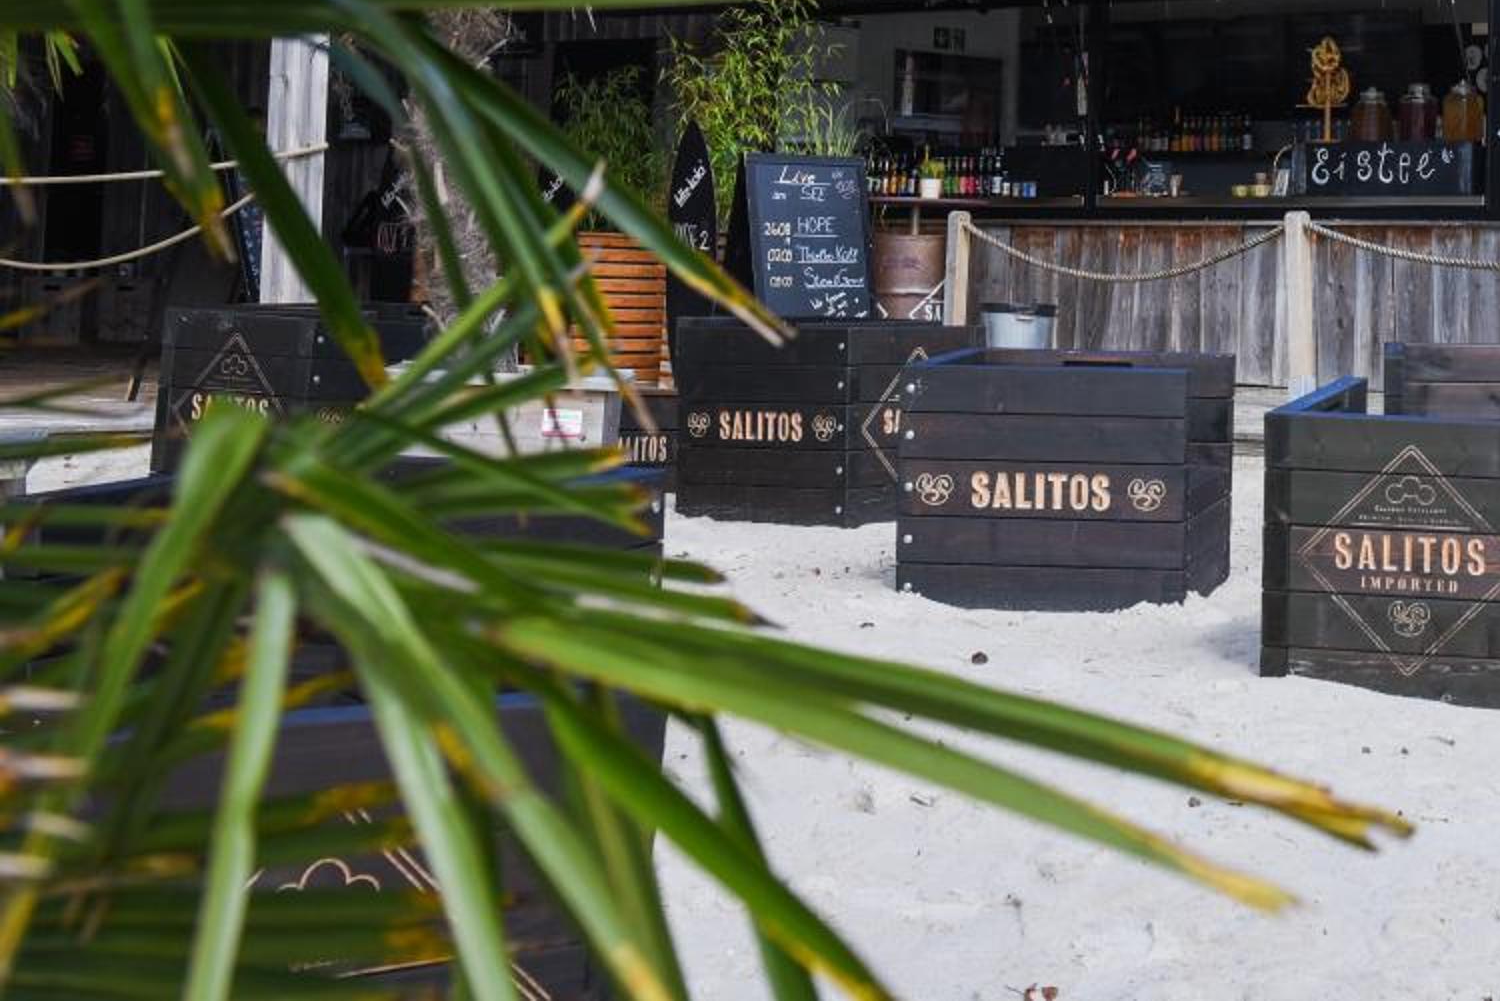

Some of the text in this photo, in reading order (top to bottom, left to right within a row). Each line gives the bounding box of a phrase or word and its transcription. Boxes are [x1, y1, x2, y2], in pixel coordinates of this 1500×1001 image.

[779, 165, 817, 184] Live
[1312, 142, 1437, 185] Eistee
[797, 215, 837, 234] HOPE
[719, 410, 803, 442] SALITOS
[970, 471, 1111, 512] SALITOS
[1334, 532, 1486, 577] SALITOS
[1360, 574, 1460, 594] IMPORTED
